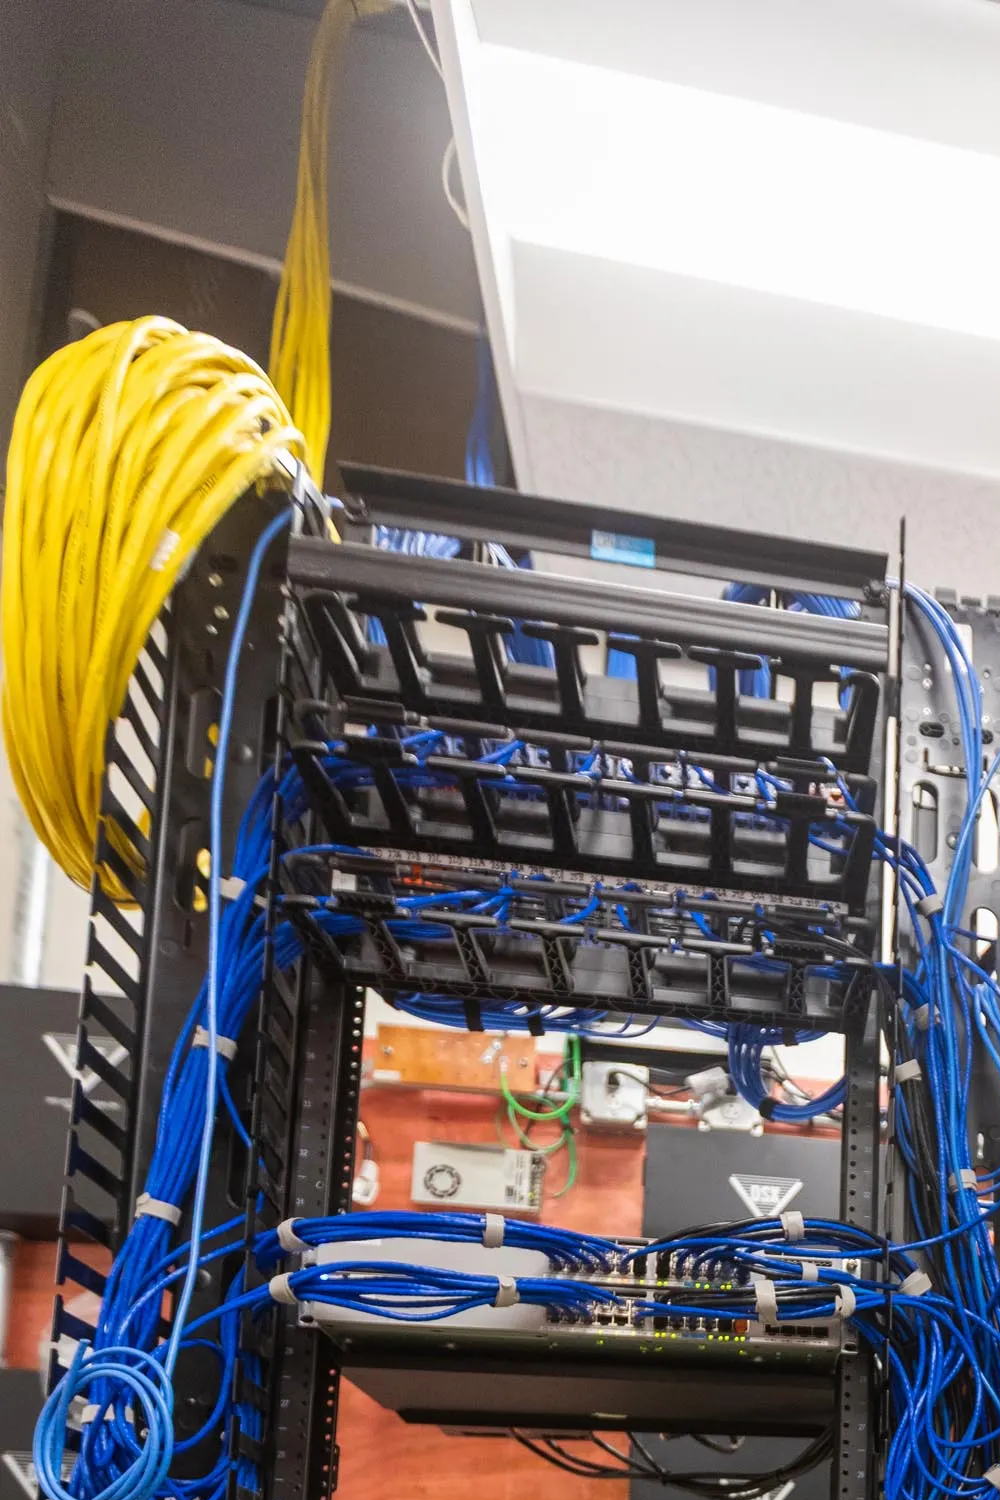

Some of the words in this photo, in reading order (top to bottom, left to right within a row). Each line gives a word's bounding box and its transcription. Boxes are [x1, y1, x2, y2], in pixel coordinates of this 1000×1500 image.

[303, 1100, 312, 1108] 33
[300, 1149, 308, 1157] 32
[296, 1197, 304, 1206] 31
[280, 1399, 290, 1408] 27
